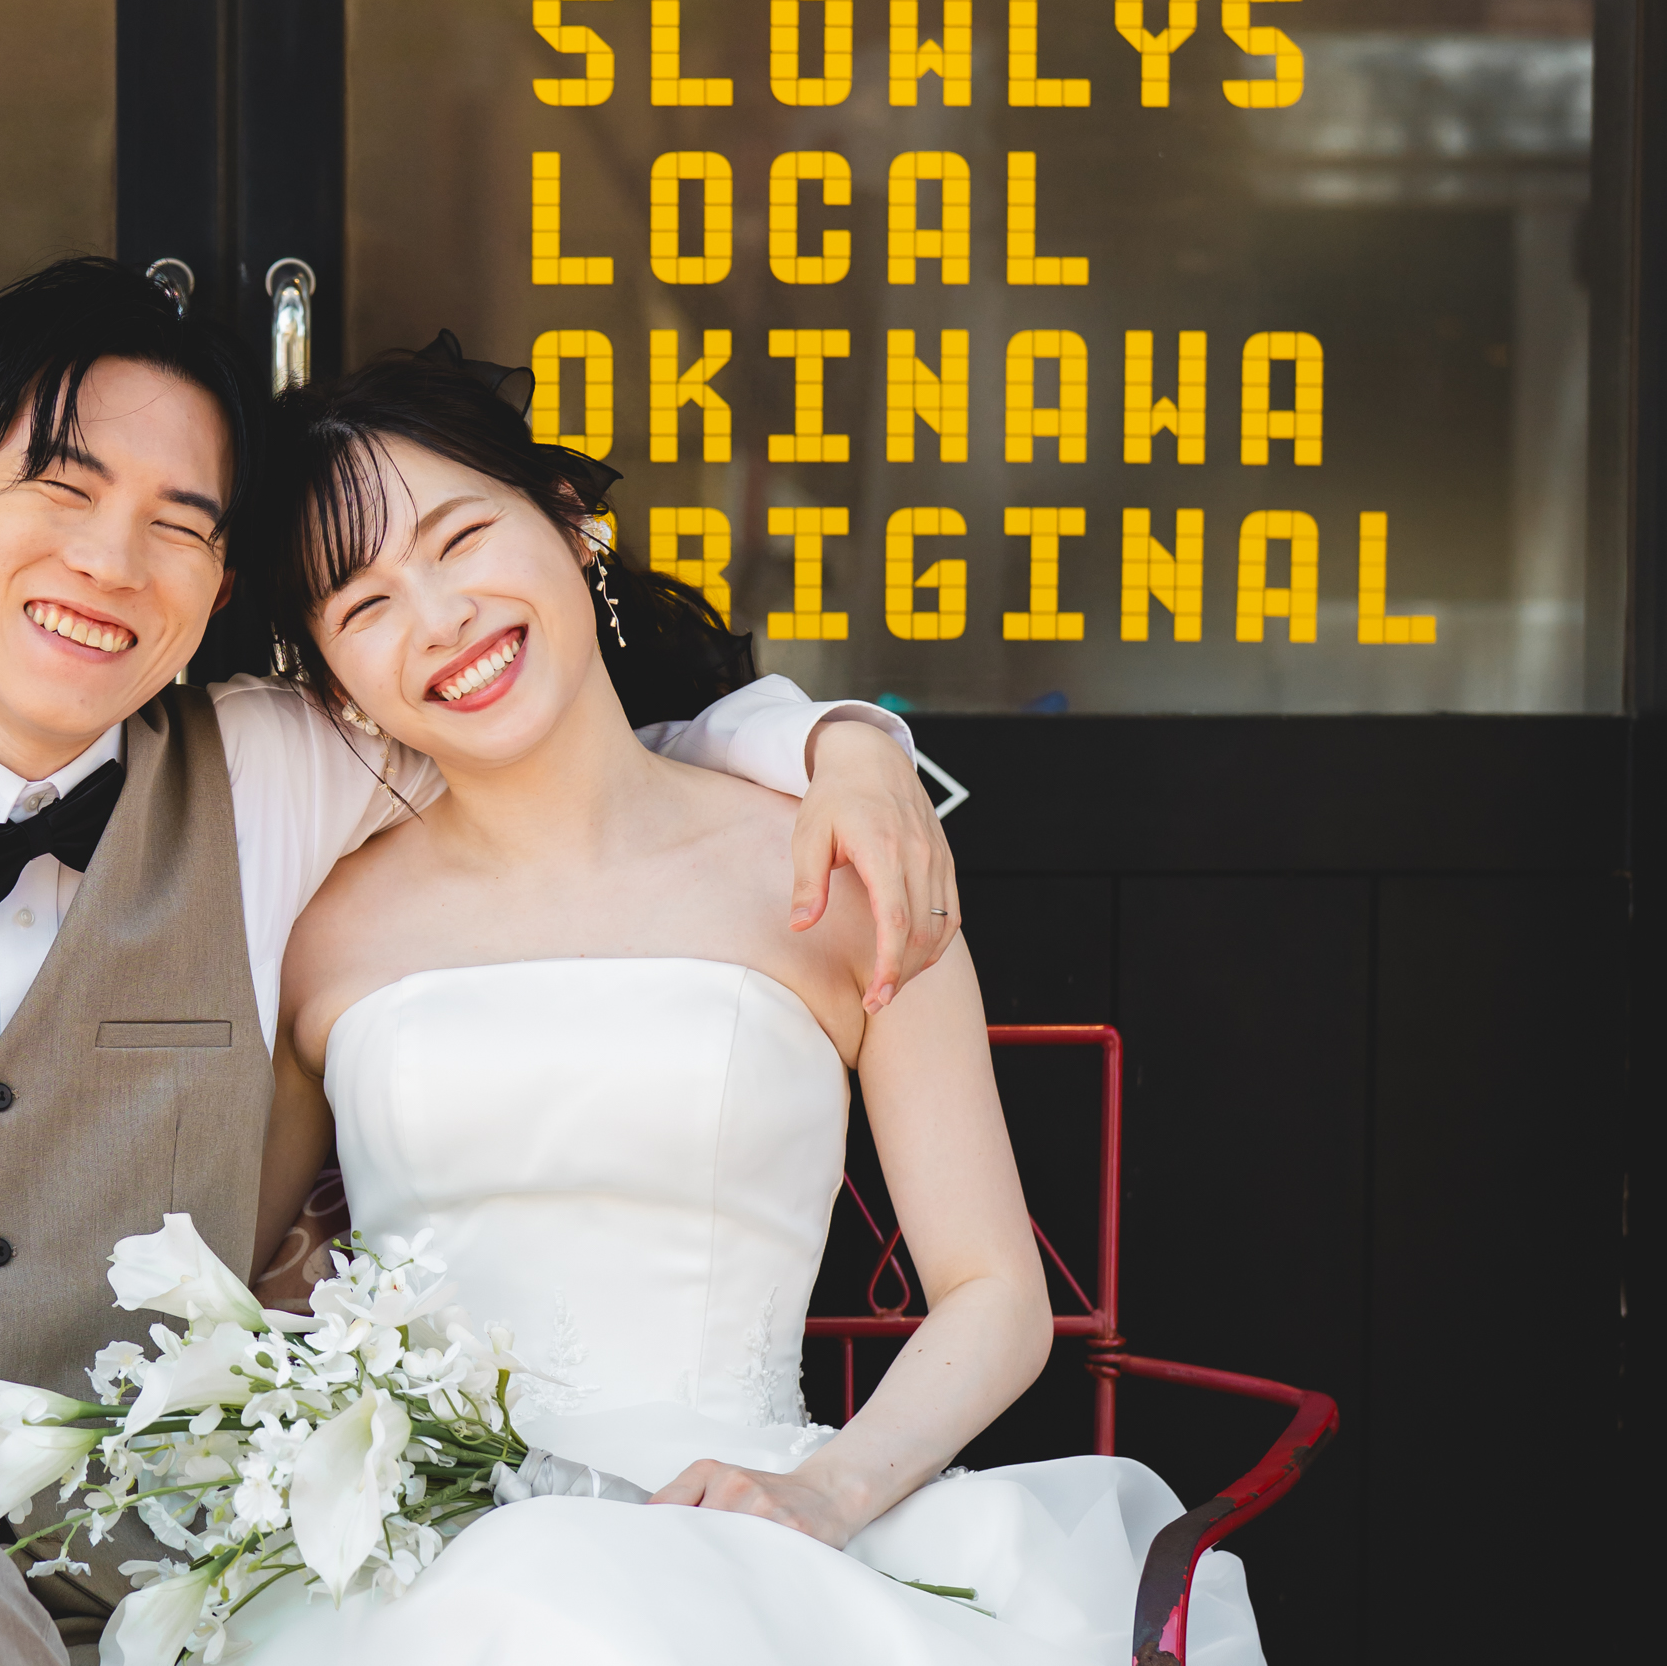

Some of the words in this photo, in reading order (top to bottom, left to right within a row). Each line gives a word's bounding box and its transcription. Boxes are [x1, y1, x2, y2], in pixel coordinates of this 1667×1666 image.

[531, 151, 1090, 286] LOCAL
[531, 329, 1324, 466] OKINAWA
[590, 507, 1438, 644] RIGINAL
